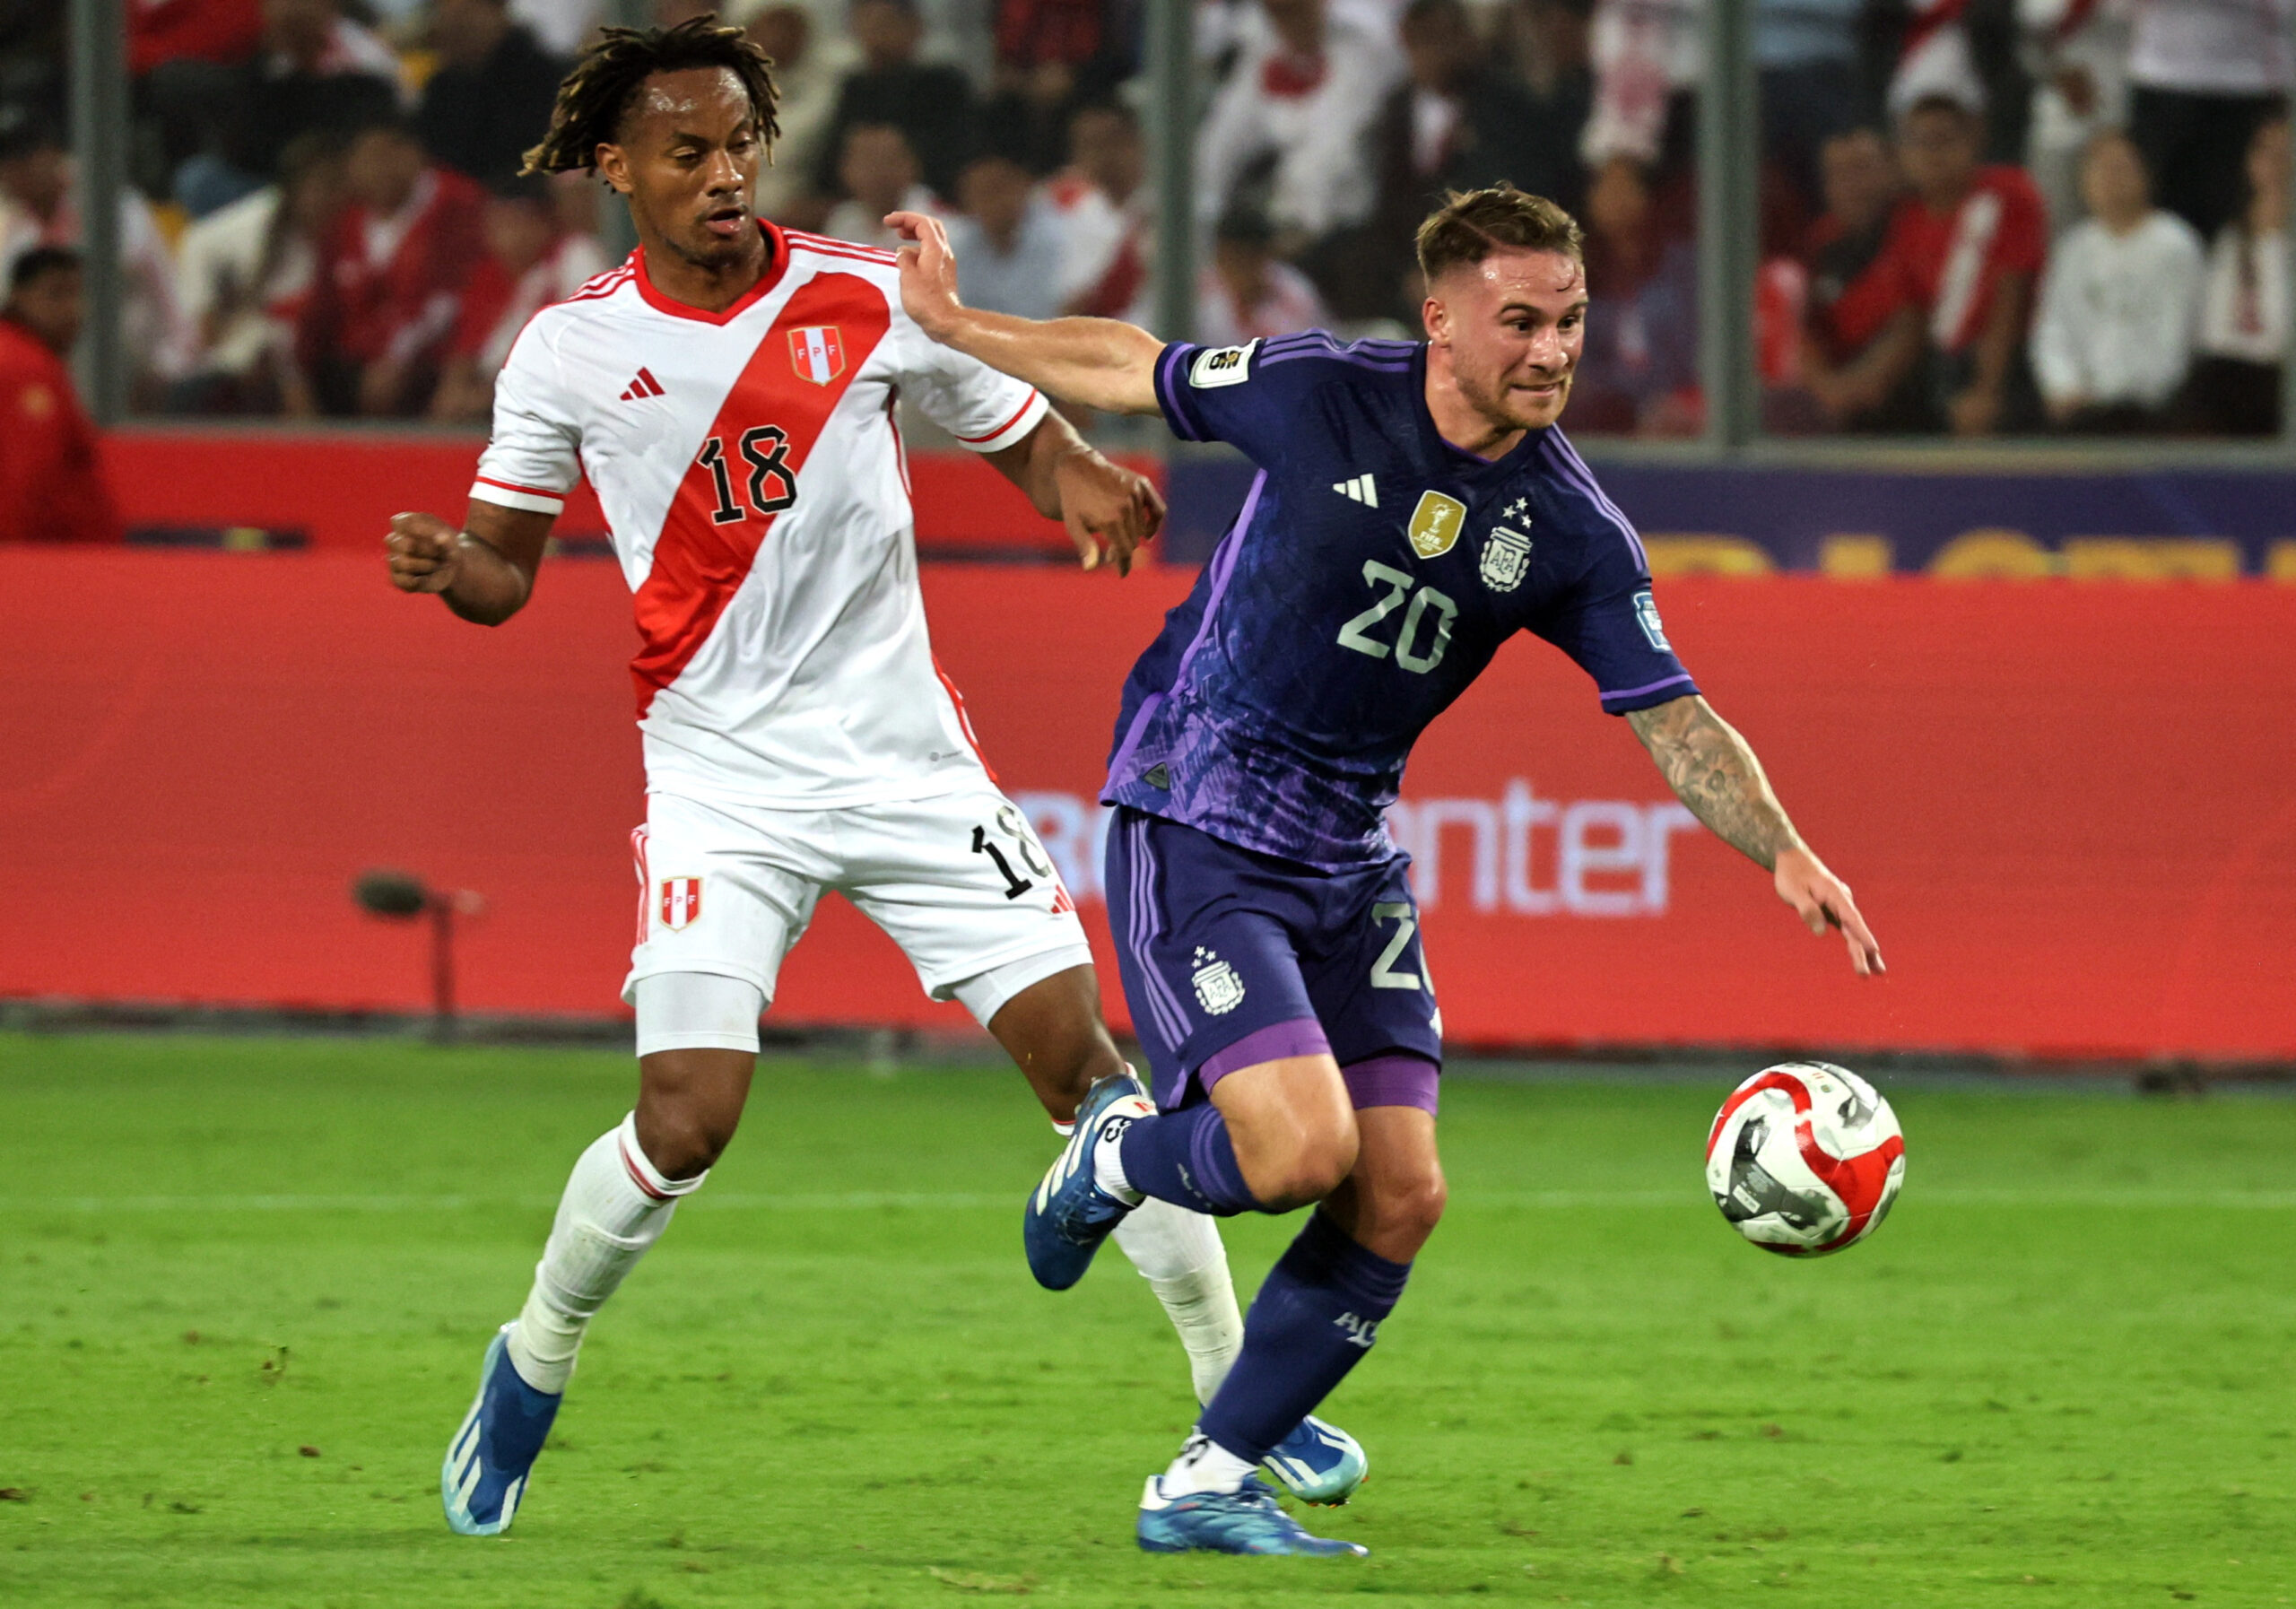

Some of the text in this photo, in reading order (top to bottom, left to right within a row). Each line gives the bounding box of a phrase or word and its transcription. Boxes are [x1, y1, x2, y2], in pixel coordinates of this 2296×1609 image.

[697, 423, 798, 526] 18
[1336, 559, 1458, 674] 20
[971, 805, 1052, 900] 18
